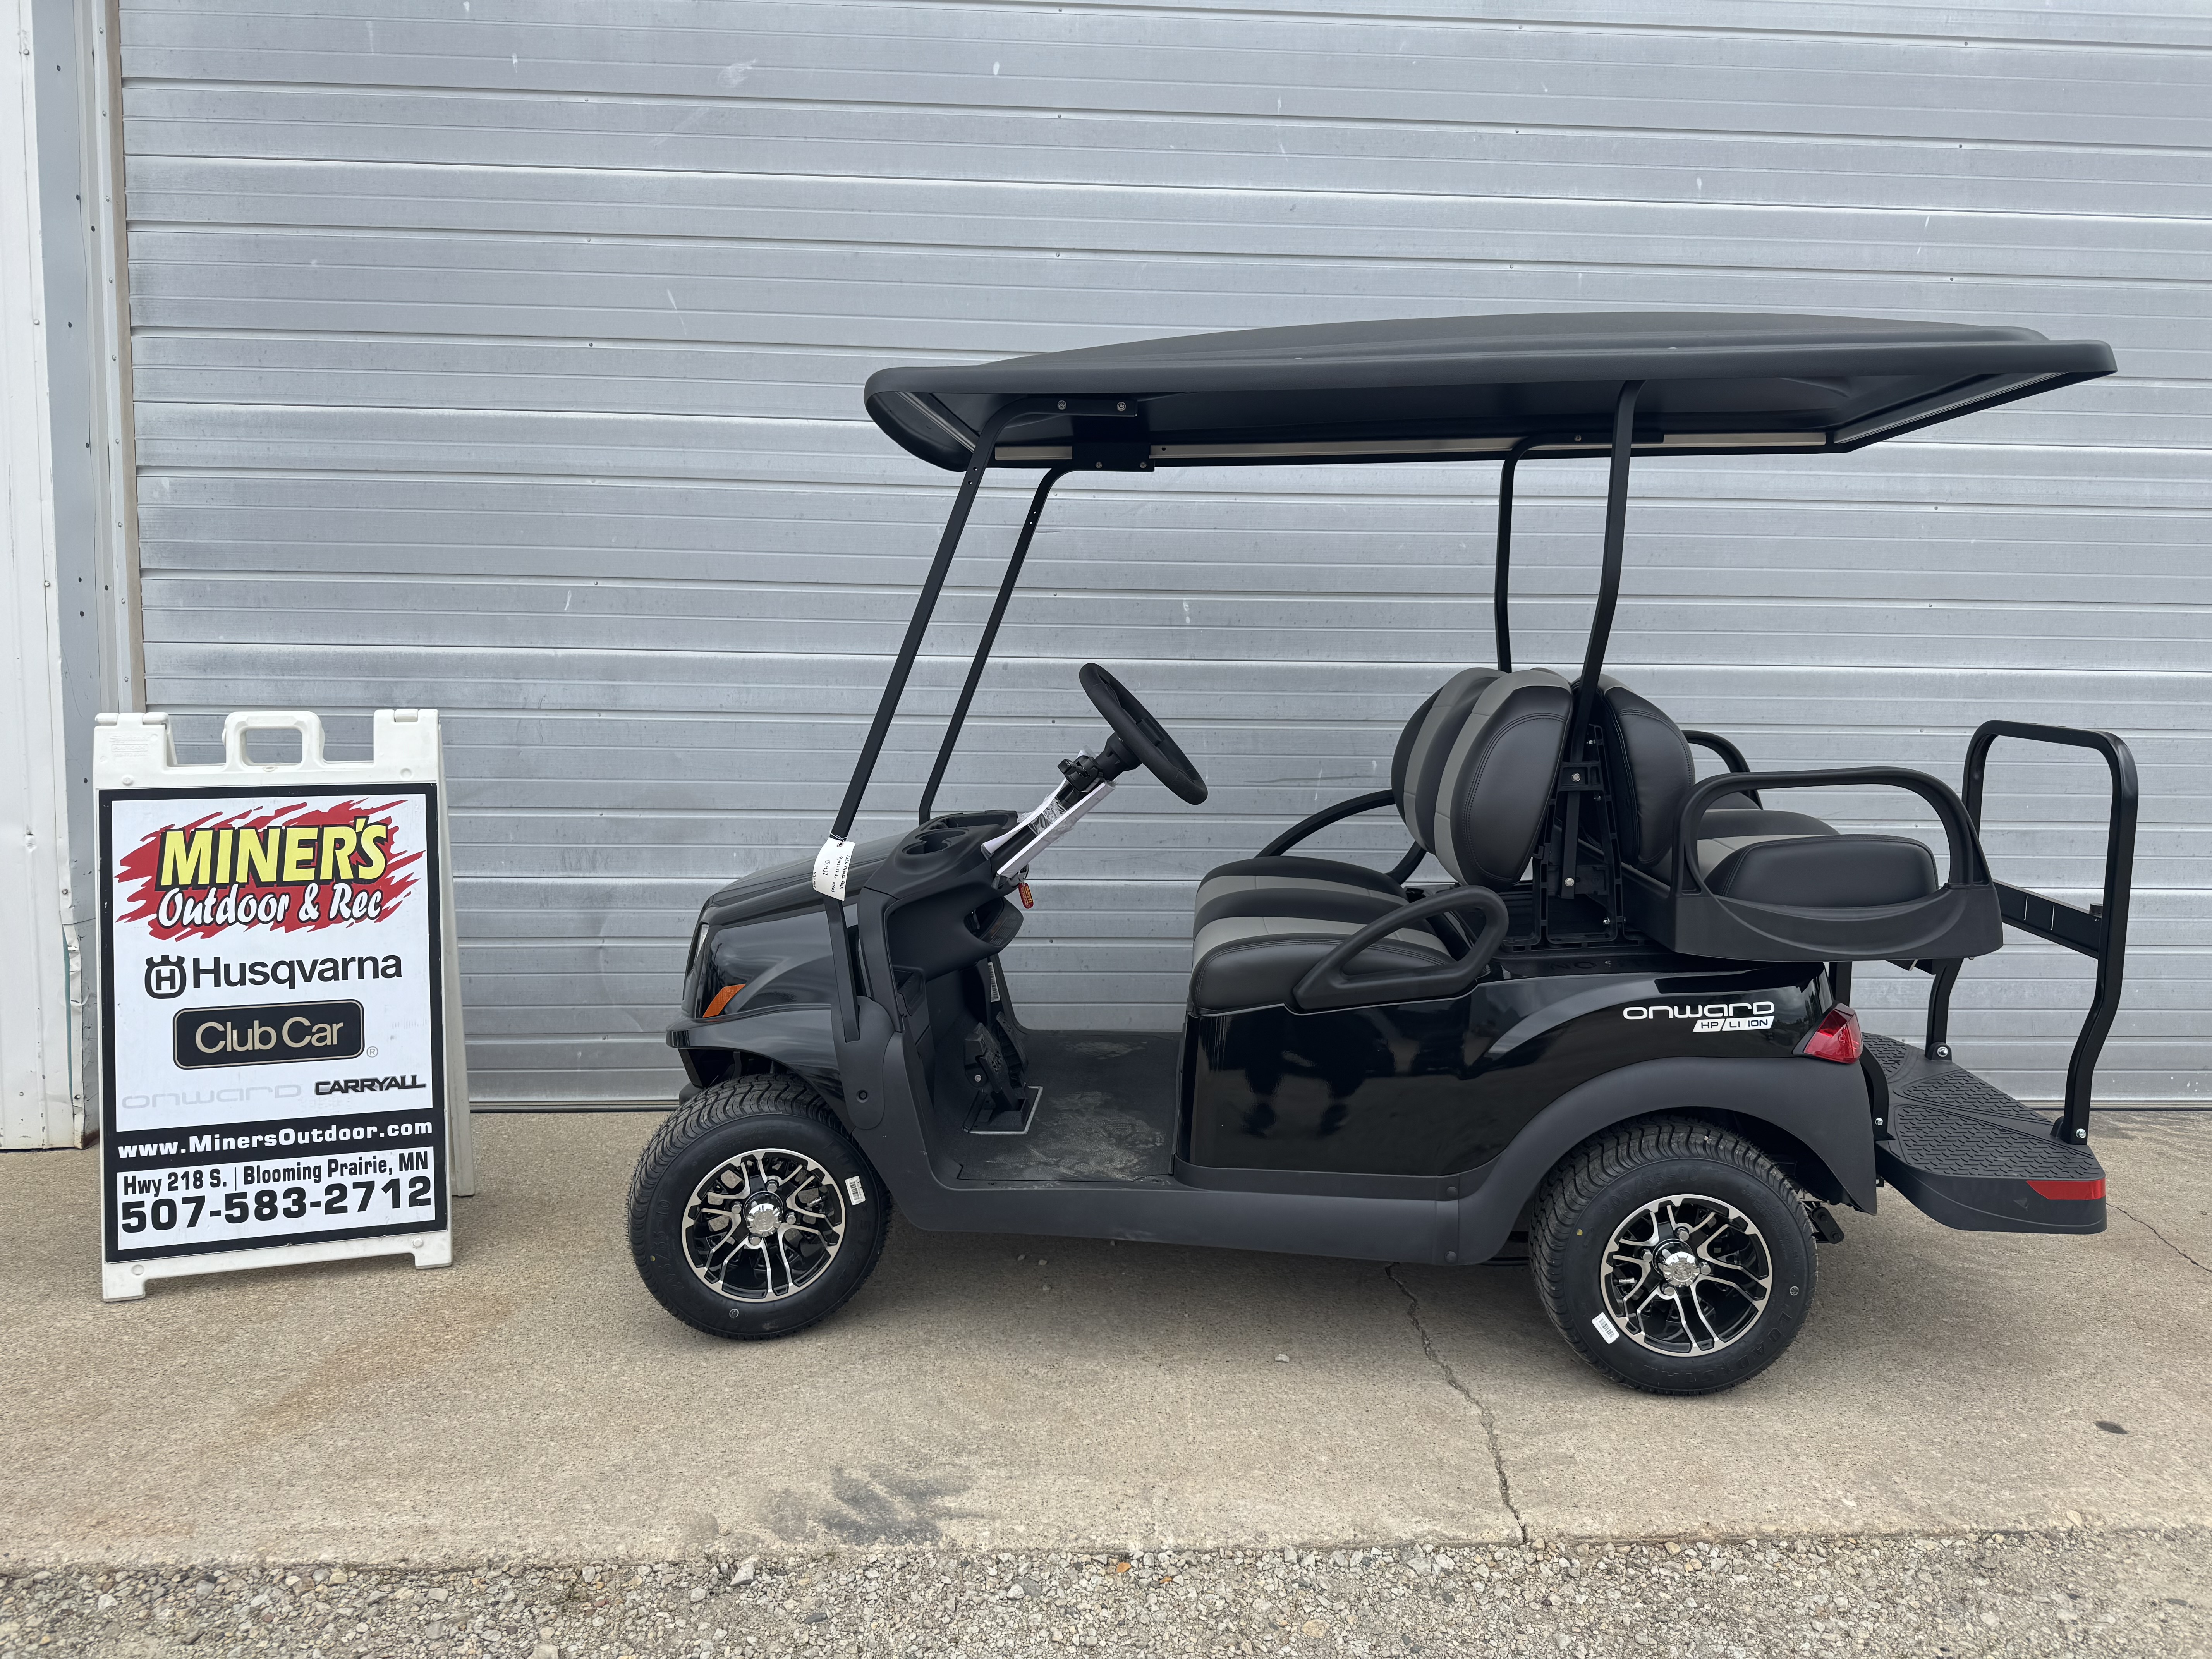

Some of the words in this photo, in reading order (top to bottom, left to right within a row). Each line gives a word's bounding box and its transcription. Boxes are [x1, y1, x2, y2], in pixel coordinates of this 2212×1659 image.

[158, 817, 388, 887] MINER'S
[158, 883, 289, 926] Outdoor
[298, 883, 320, 922] &
[329, 883, 383, 920] Rec
[193, 955, 402, 989] Husqvarna
[195, 1020, 277, 1053] Club
[282, 1017, 344, 1048] Car
[1748, 1019, 1768, 1027] ION
[314, 1074, 427, 1096] CARRYALL
[118, 1121, 433, 1158] www.MinersOutdoor.com
[124, 1175, 162, 1197] Hwy
[167, 1170, 204, 1191] 218
[210, 1168, 227, 1187] S.
[244, 1161, 322, 1185] Blooming
[328, 1156, 393, 1178] Prairie,
[399, 1151, 428, 1171] MN
[122, 1176, 432, 1233] 507-583-2712
